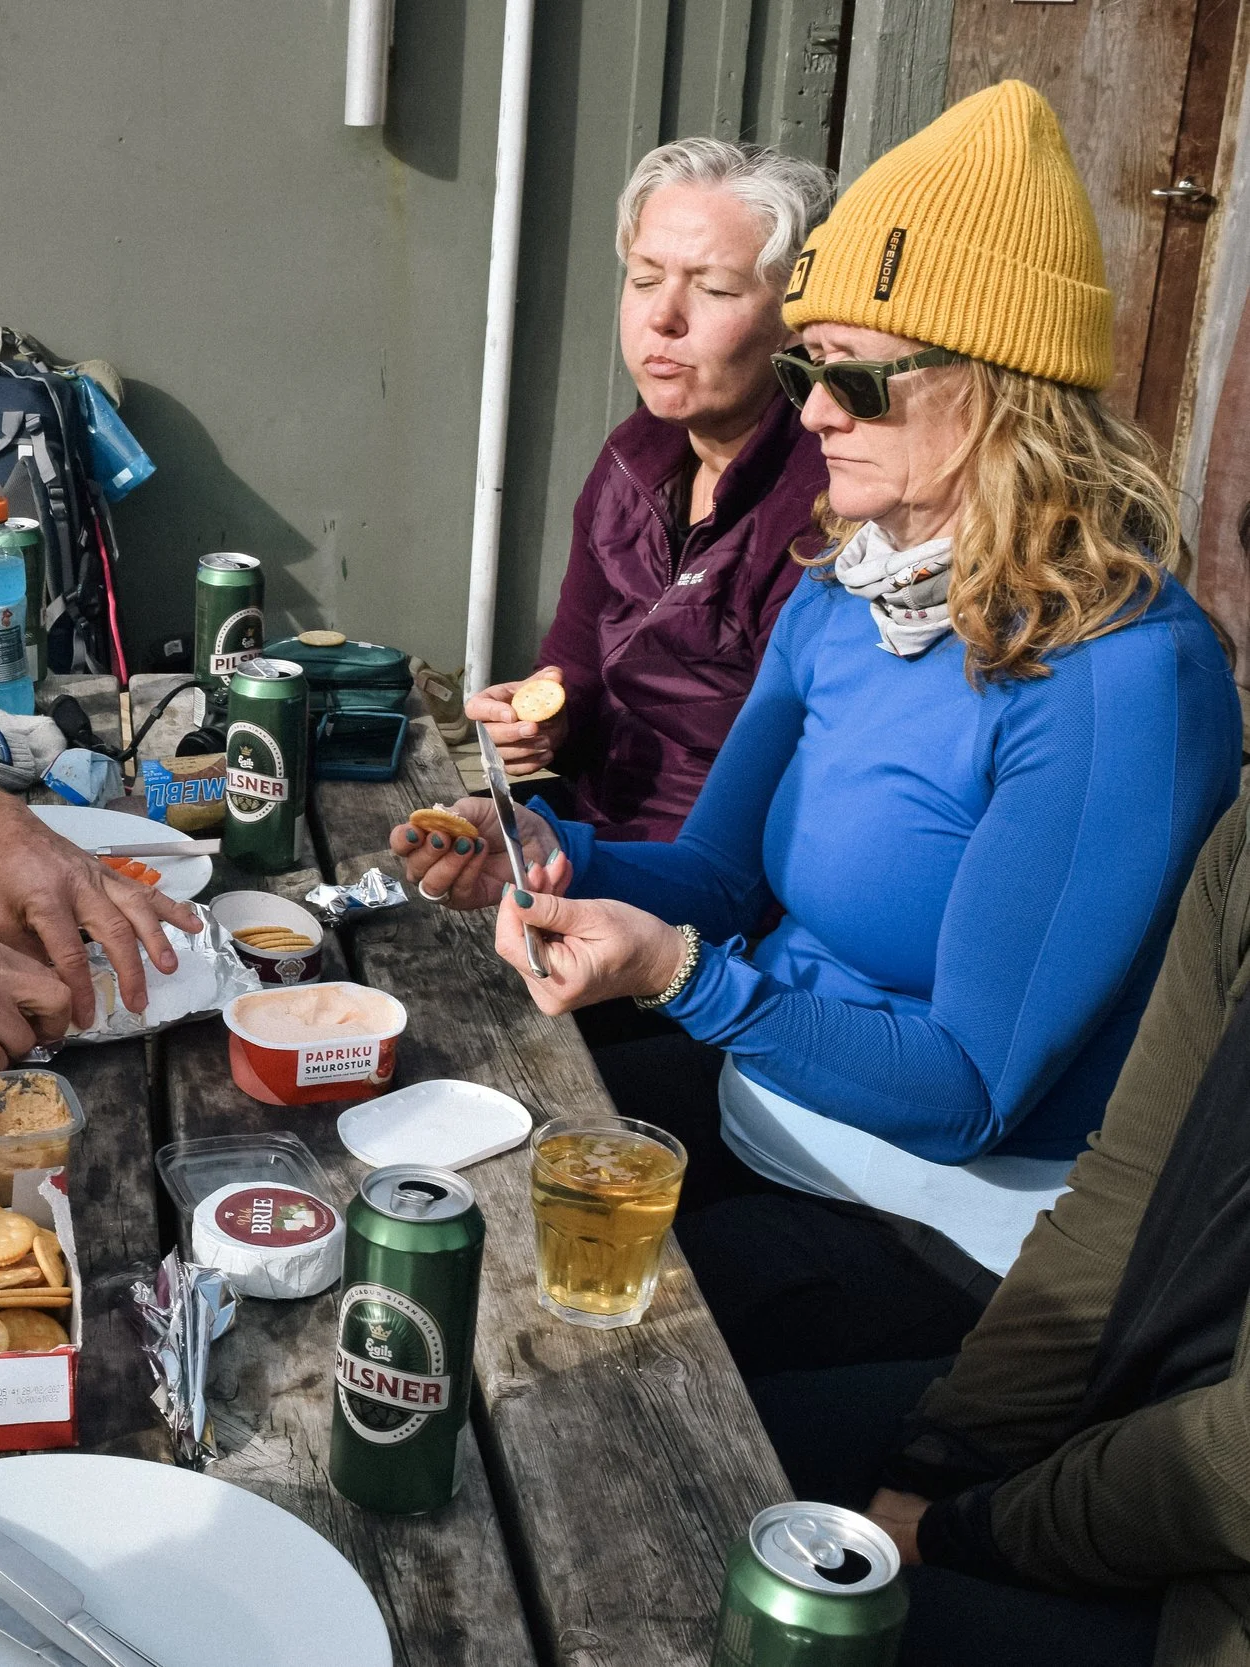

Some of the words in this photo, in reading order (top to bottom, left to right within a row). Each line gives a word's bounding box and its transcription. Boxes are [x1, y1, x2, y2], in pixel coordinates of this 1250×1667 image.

[878, 231, 902, 293] DEFENDER
[227, 771, 283, 797] ILSNER
[305, 1046, 372, 1064] PAPRIKU
[305, 1060, 372, 1074] SMUROSTUR
[251, 1198, 274, 1235] BRIE
[365, 1337, 393, 1362] Egils
[335, 1351, 442, 1405] PILSNER
